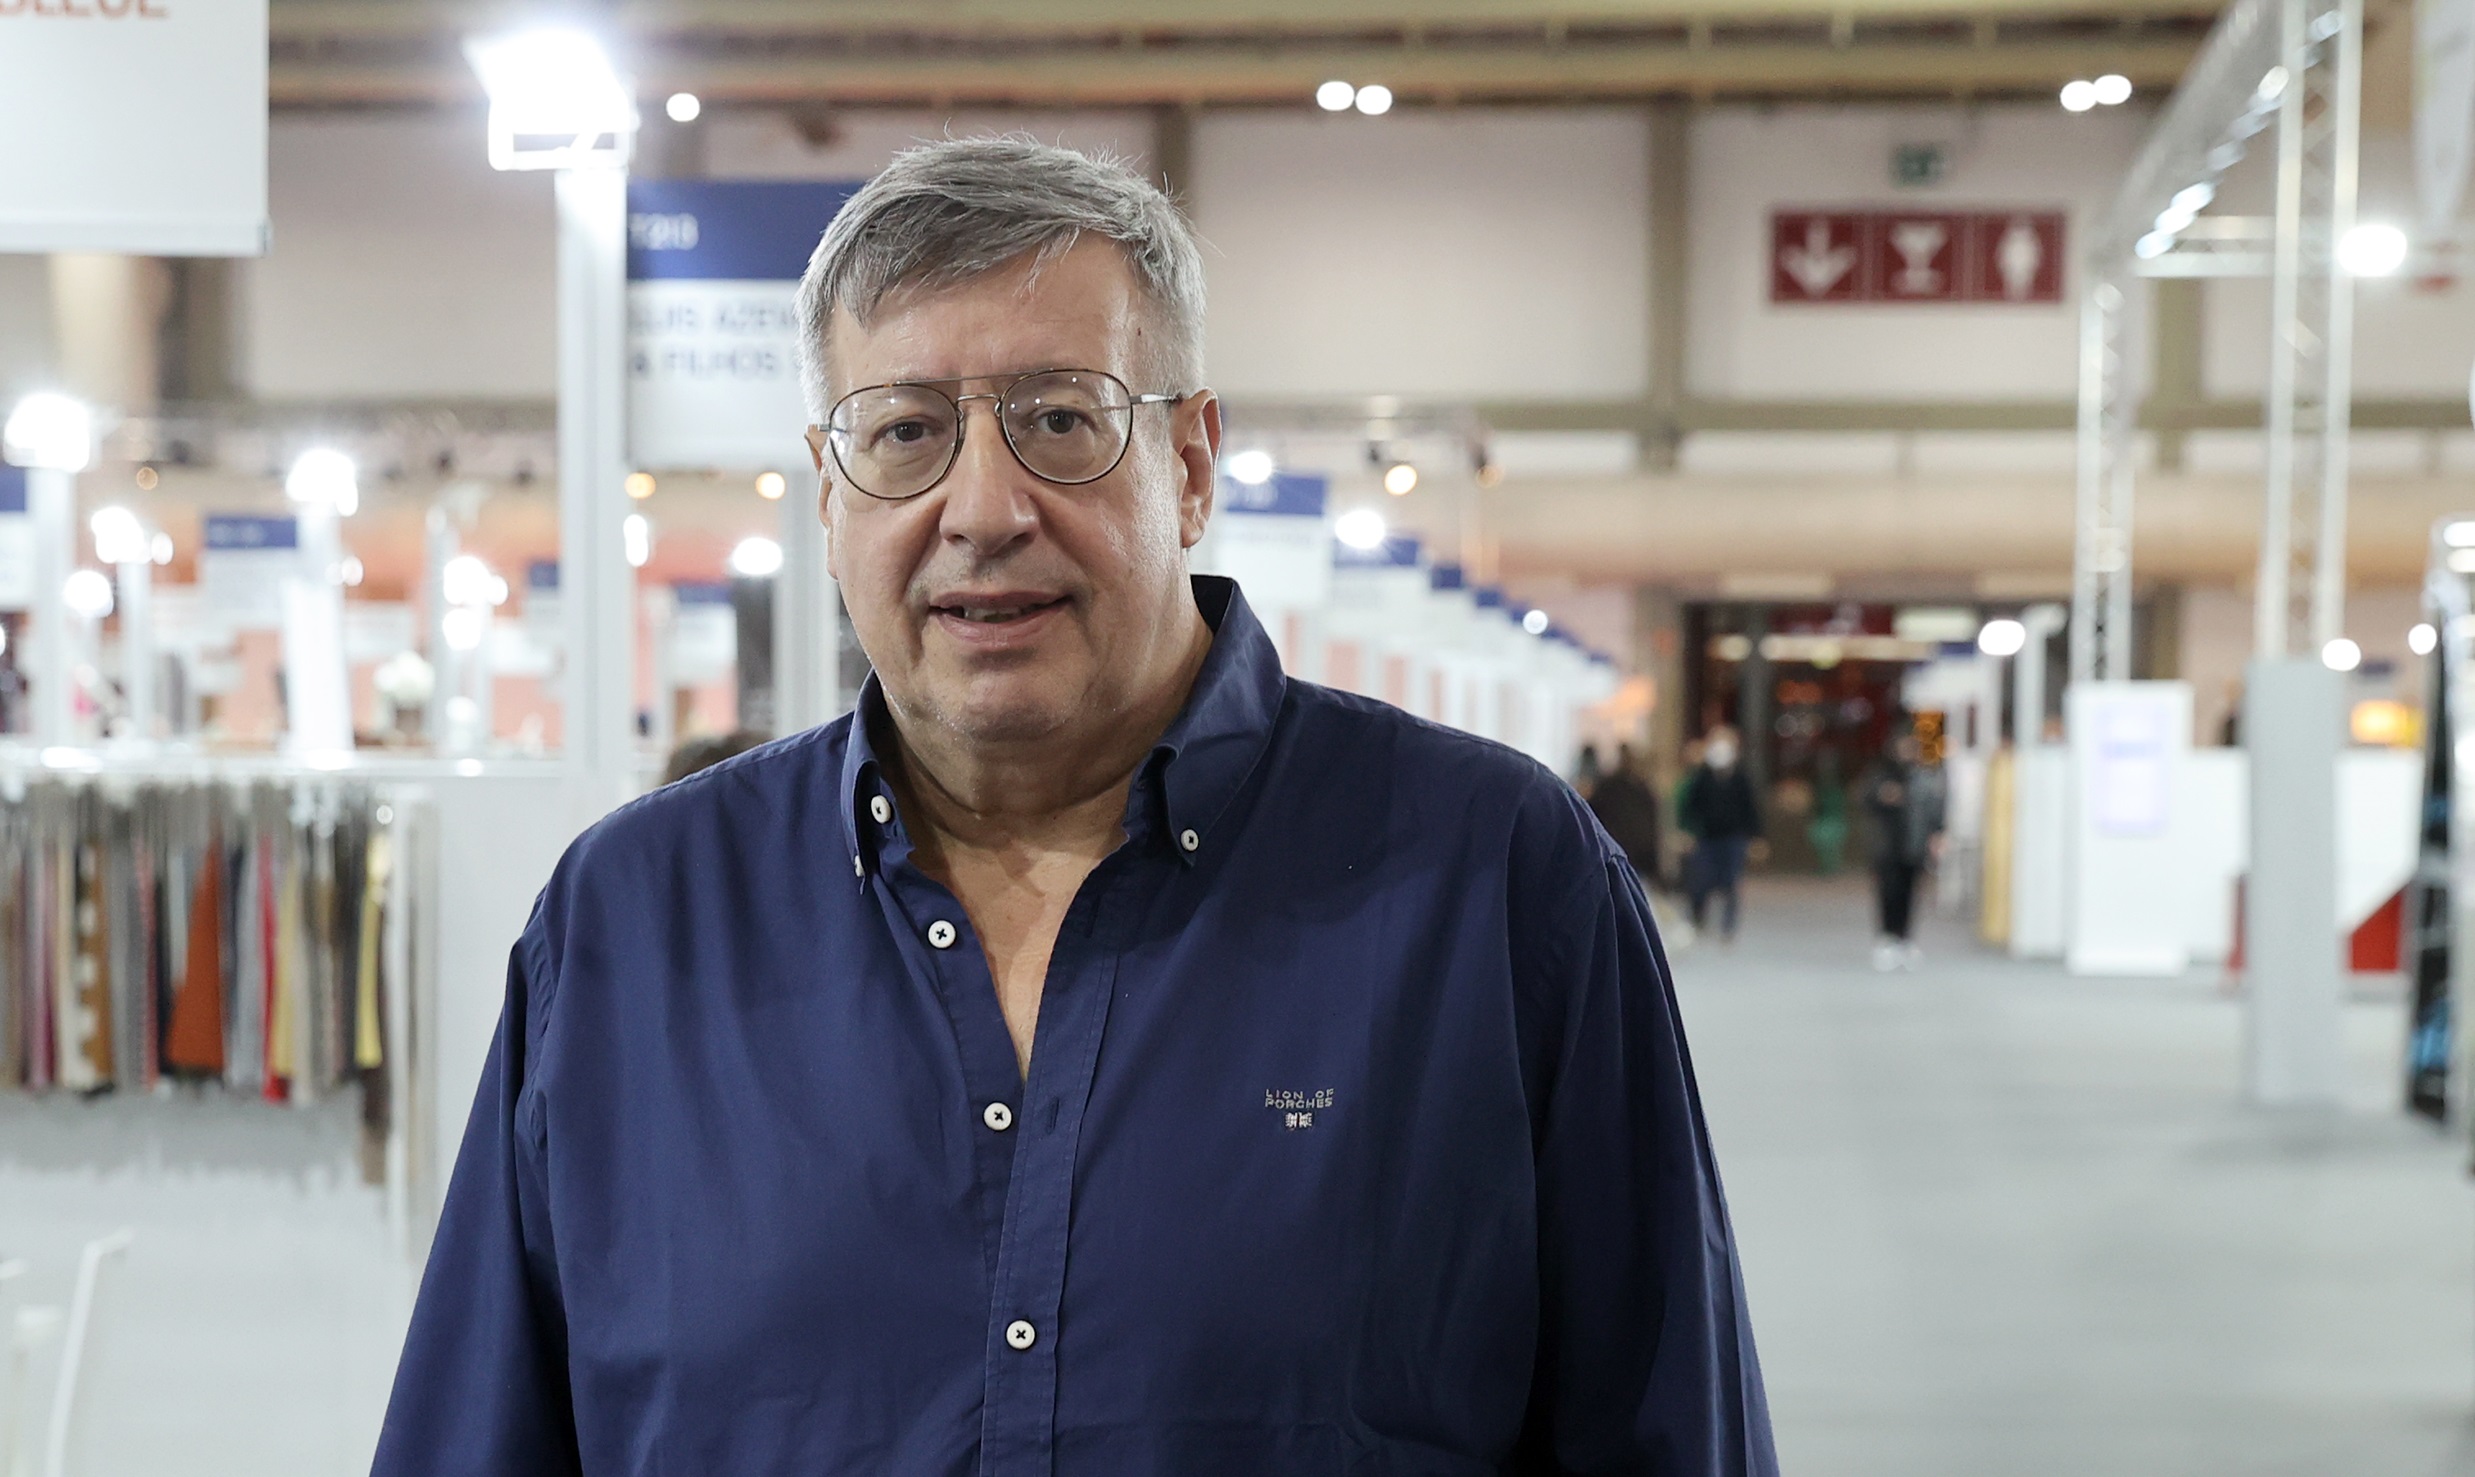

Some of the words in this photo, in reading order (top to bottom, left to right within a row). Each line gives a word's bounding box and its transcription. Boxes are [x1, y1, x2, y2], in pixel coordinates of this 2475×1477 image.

[663, 350, 782, 382] FILHOS
[1265, 1088, 1304, 1099] LION
[1315, 1088, 1335, 1098] OF
[1265, 1098, 1333, 1109] PORCHES
